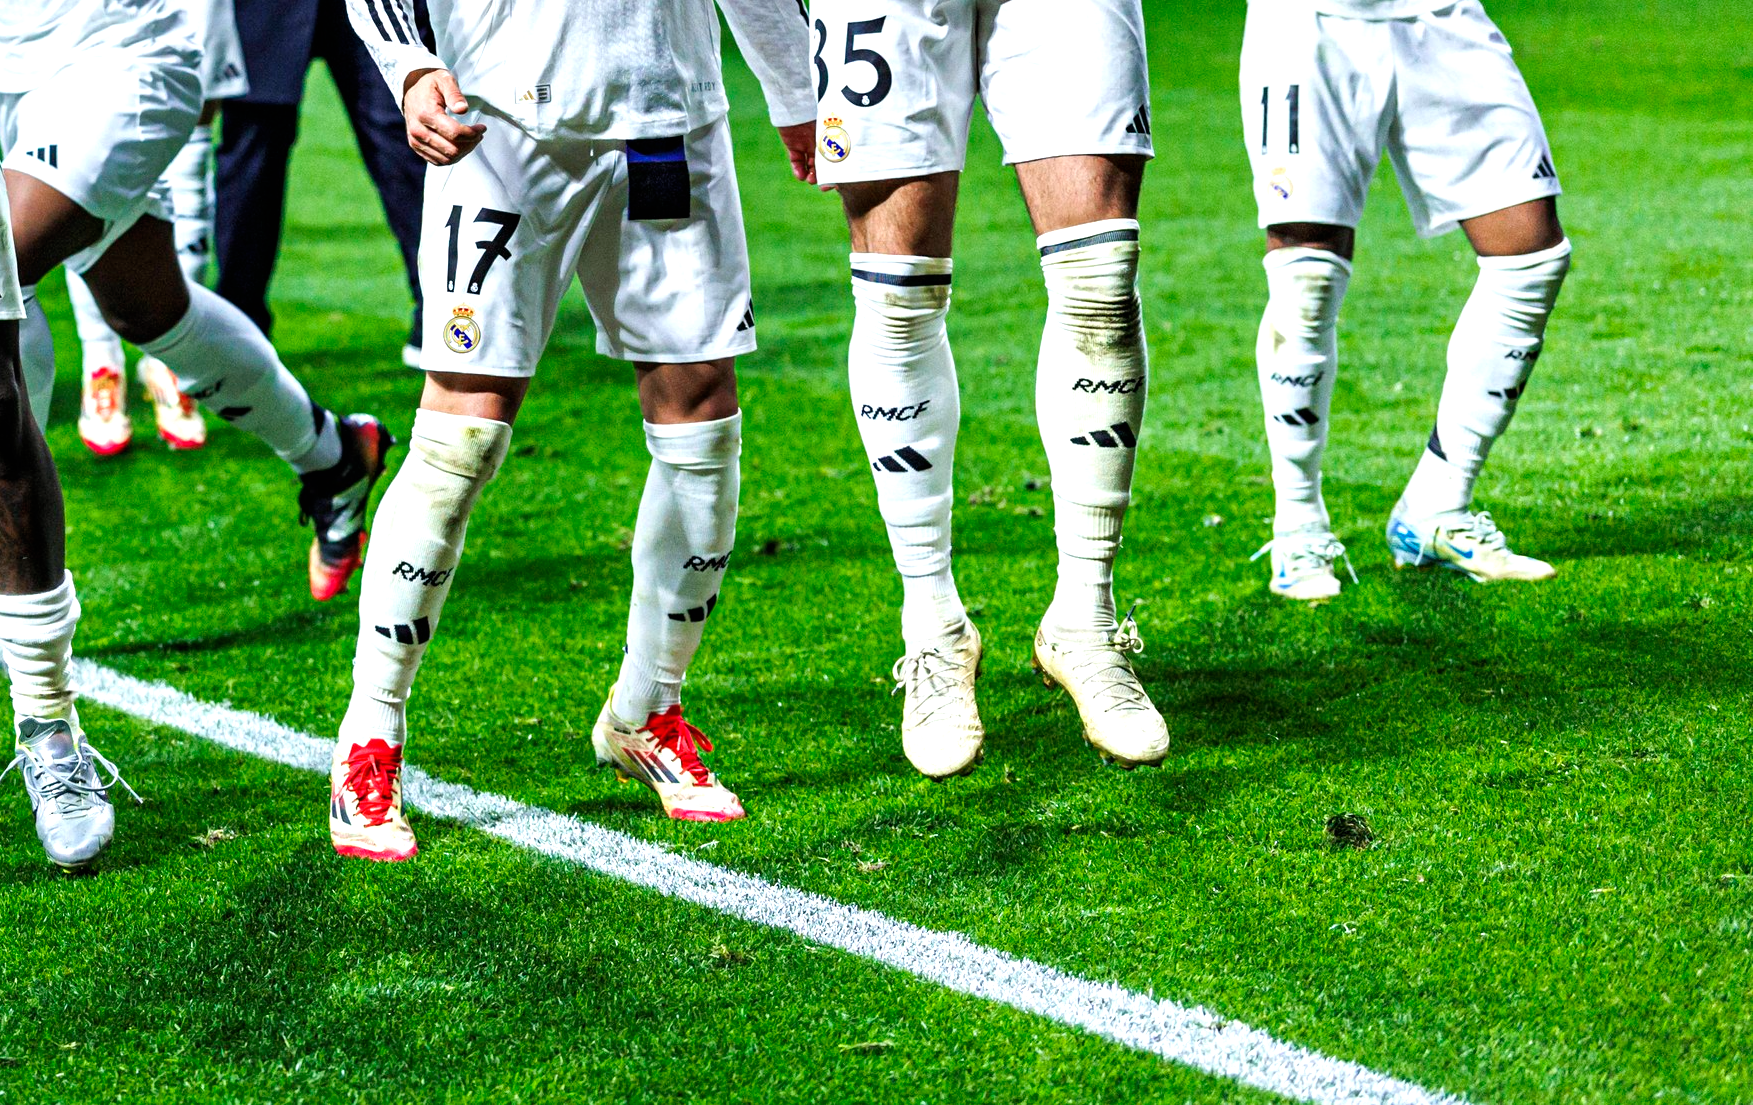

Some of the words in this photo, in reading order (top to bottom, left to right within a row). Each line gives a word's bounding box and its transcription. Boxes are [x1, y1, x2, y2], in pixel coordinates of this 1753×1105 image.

[1261, 85, 1300, 155] 11
[445, 205, 521, 295] 17
[861, 399, 930, 422] RMCF
